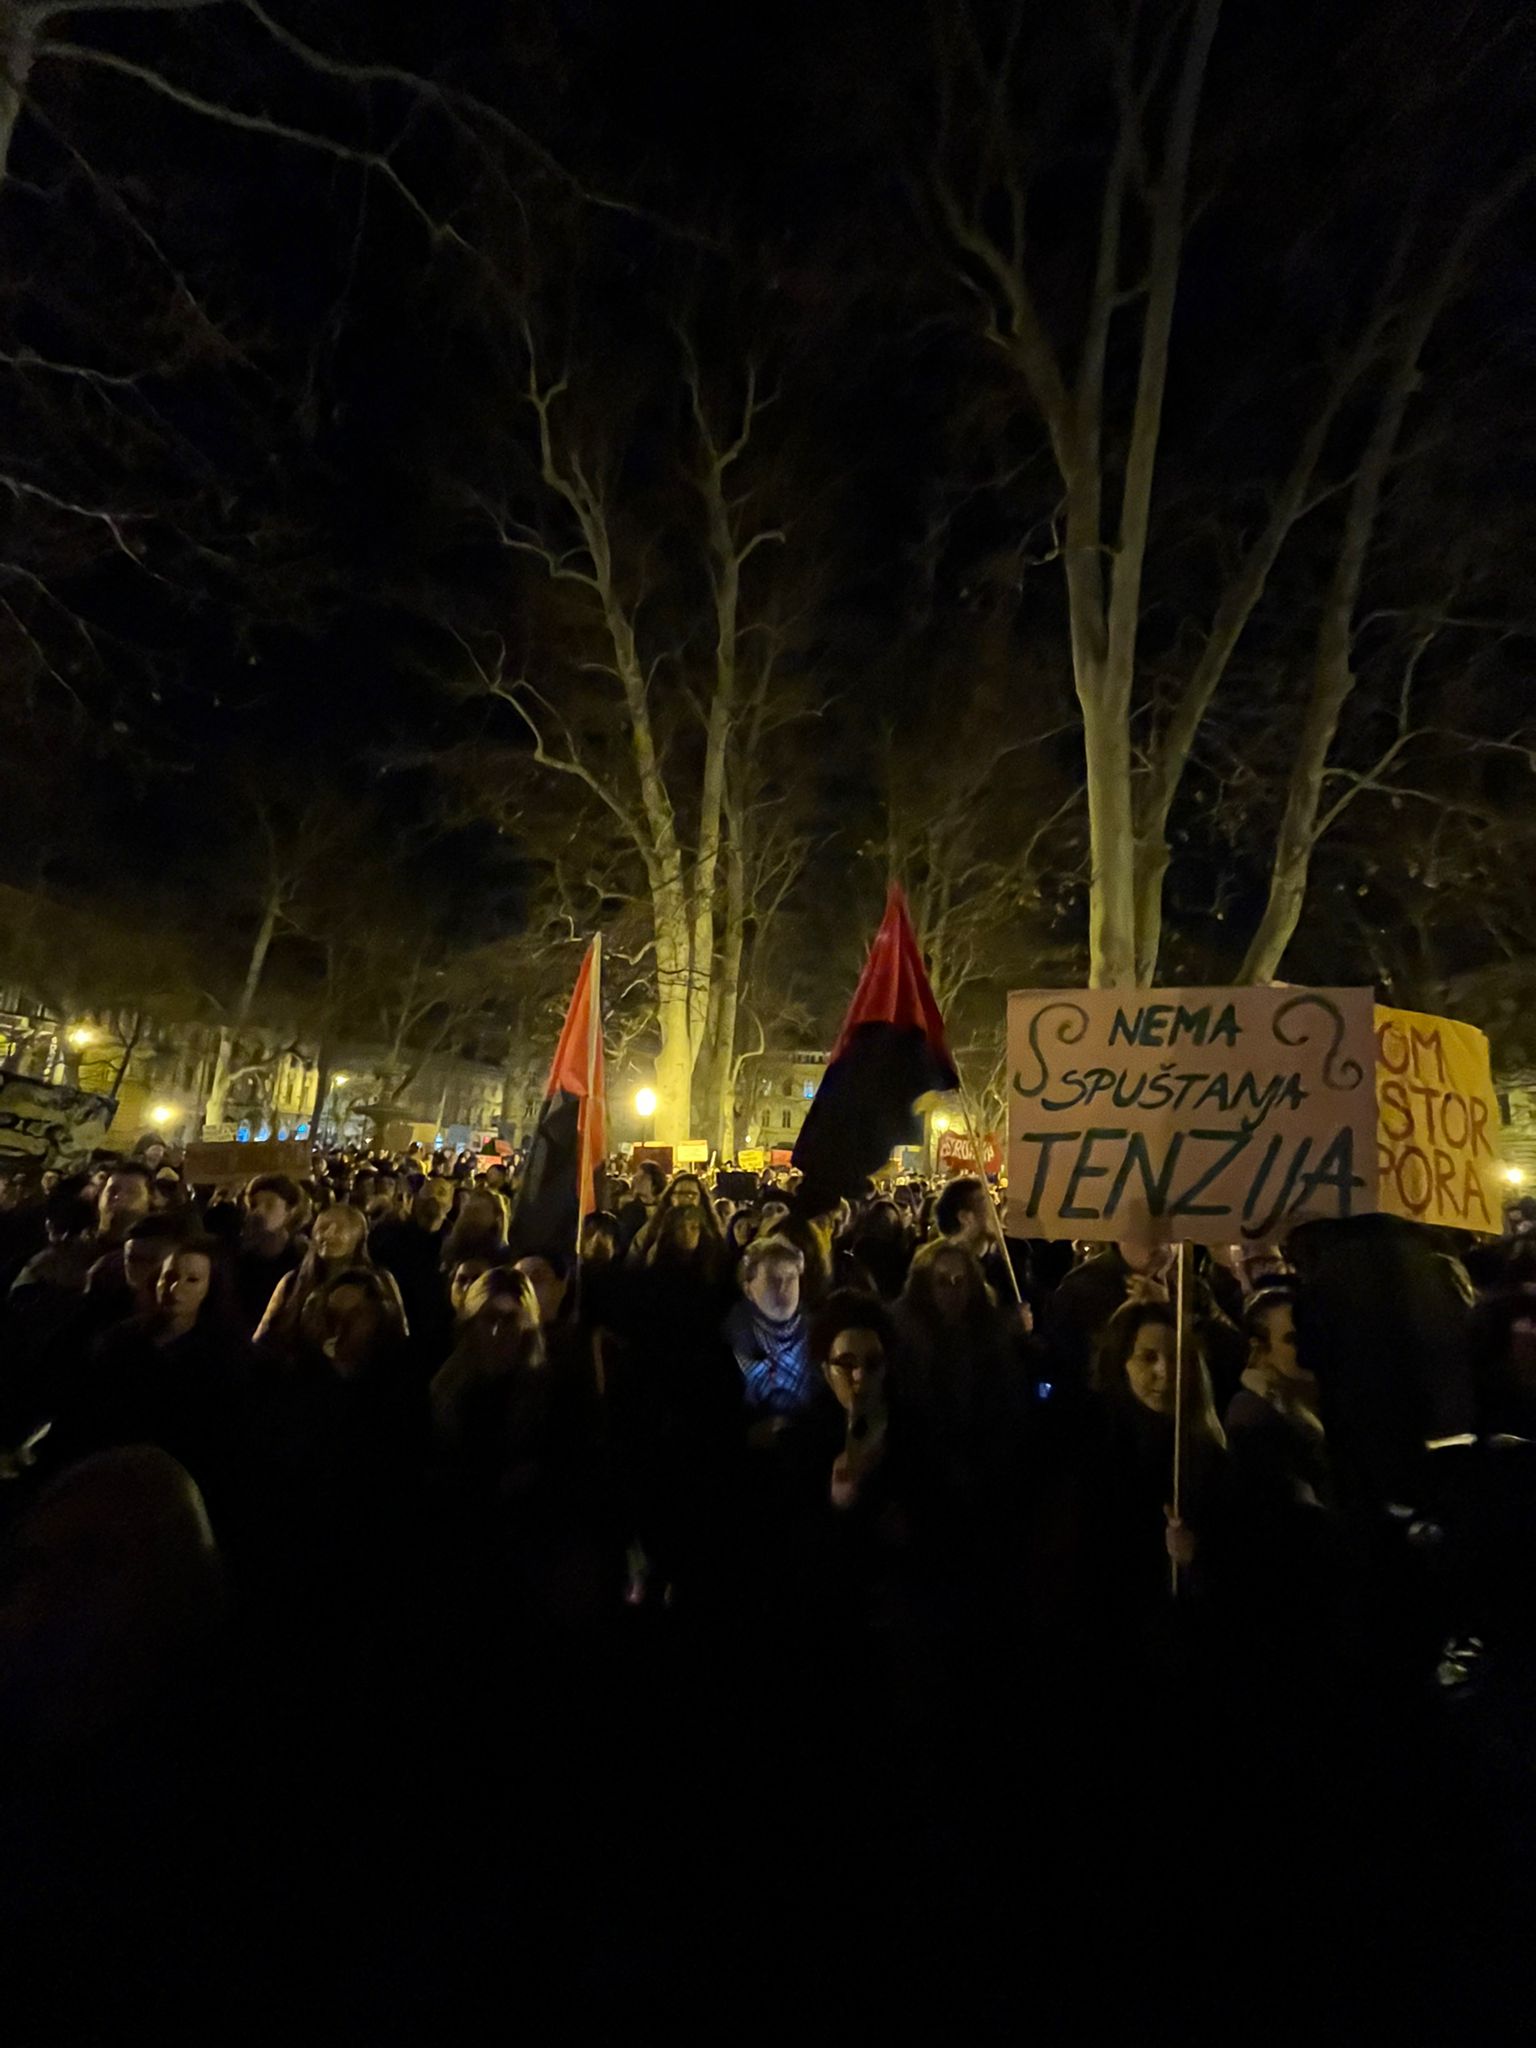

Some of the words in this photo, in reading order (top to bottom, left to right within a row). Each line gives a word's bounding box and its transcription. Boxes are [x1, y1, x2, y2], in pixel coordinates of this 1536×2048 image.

[1108, 1004, 1242, 1046] NEMA
[1041, 1063, 1310, 1129] SPUŠTANJA
[1022, 1126, 1366, 1238] TENZIJA
